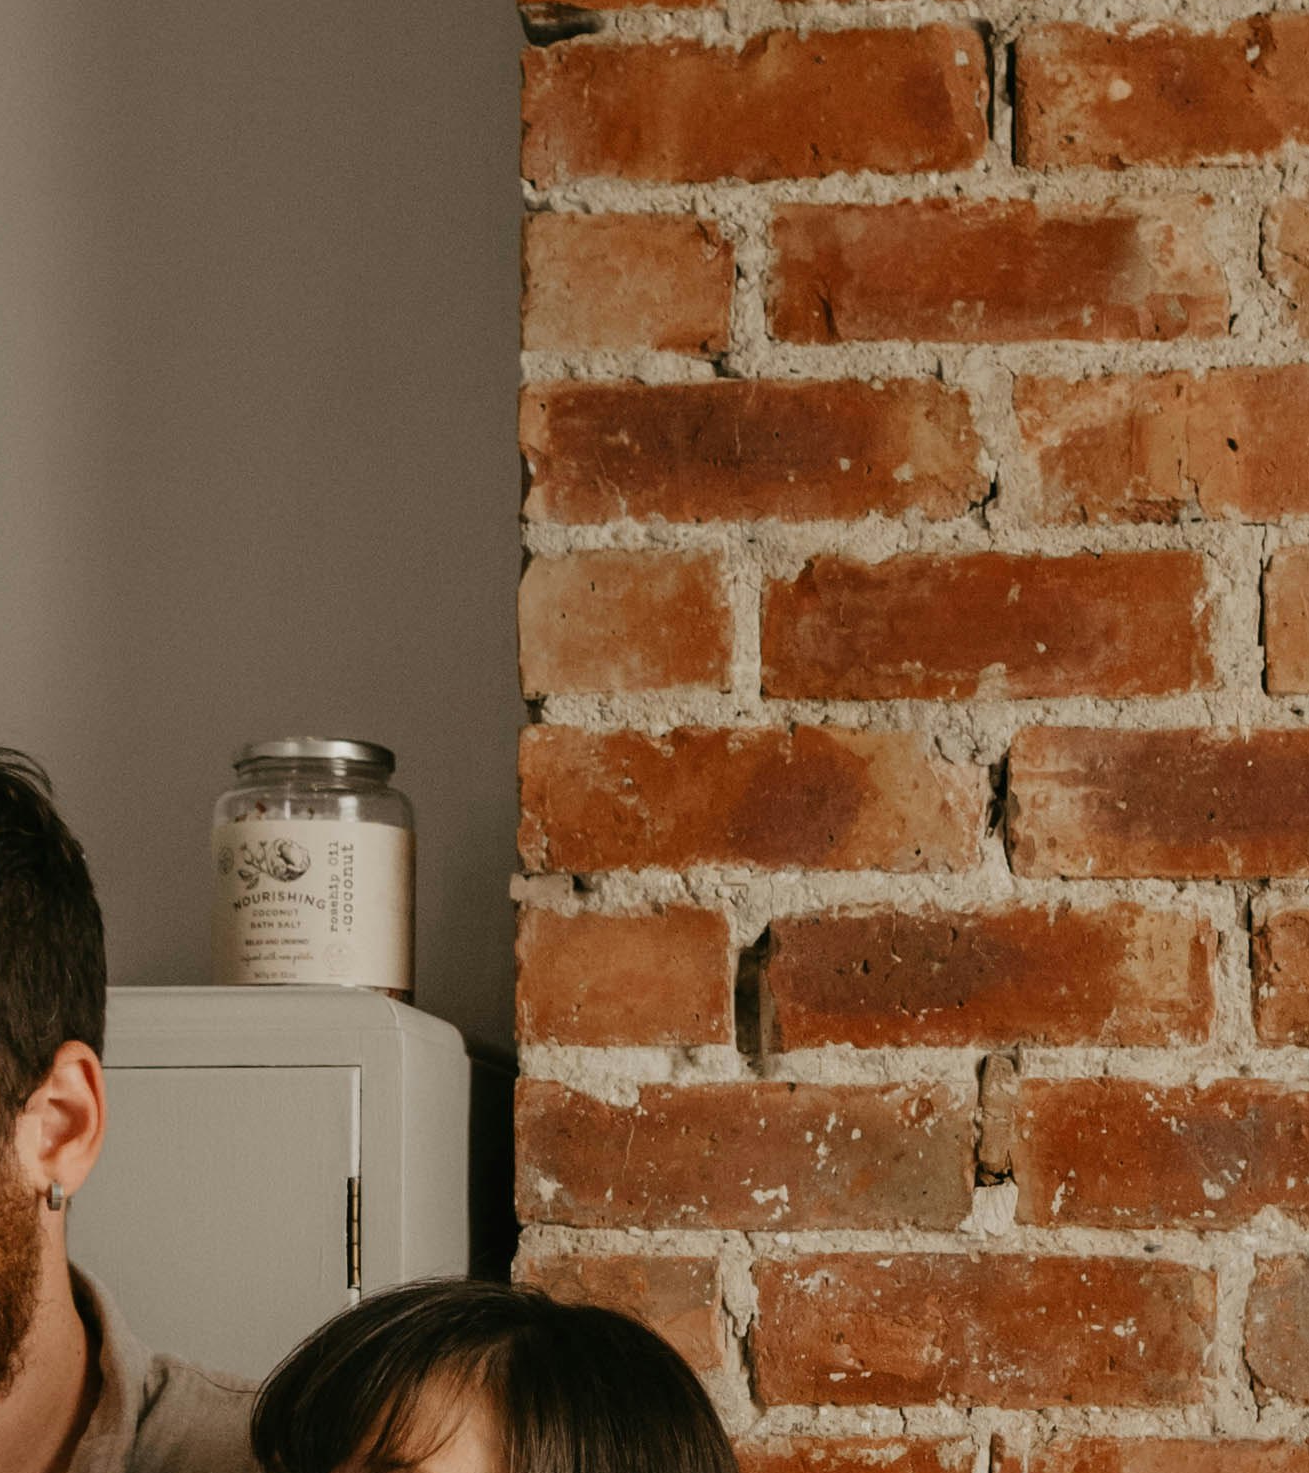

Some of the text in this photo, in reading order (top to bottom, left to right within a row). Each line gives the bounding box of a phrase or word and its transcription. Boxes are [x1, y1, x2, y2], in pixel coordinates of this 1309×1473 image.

[232, 891, 327, 912] NOURISHING
[329, 874, 340, 933] rosehip
[252, 908, 299, 917] COCONUT
[250, 921, 302, 929] BATH SALT
